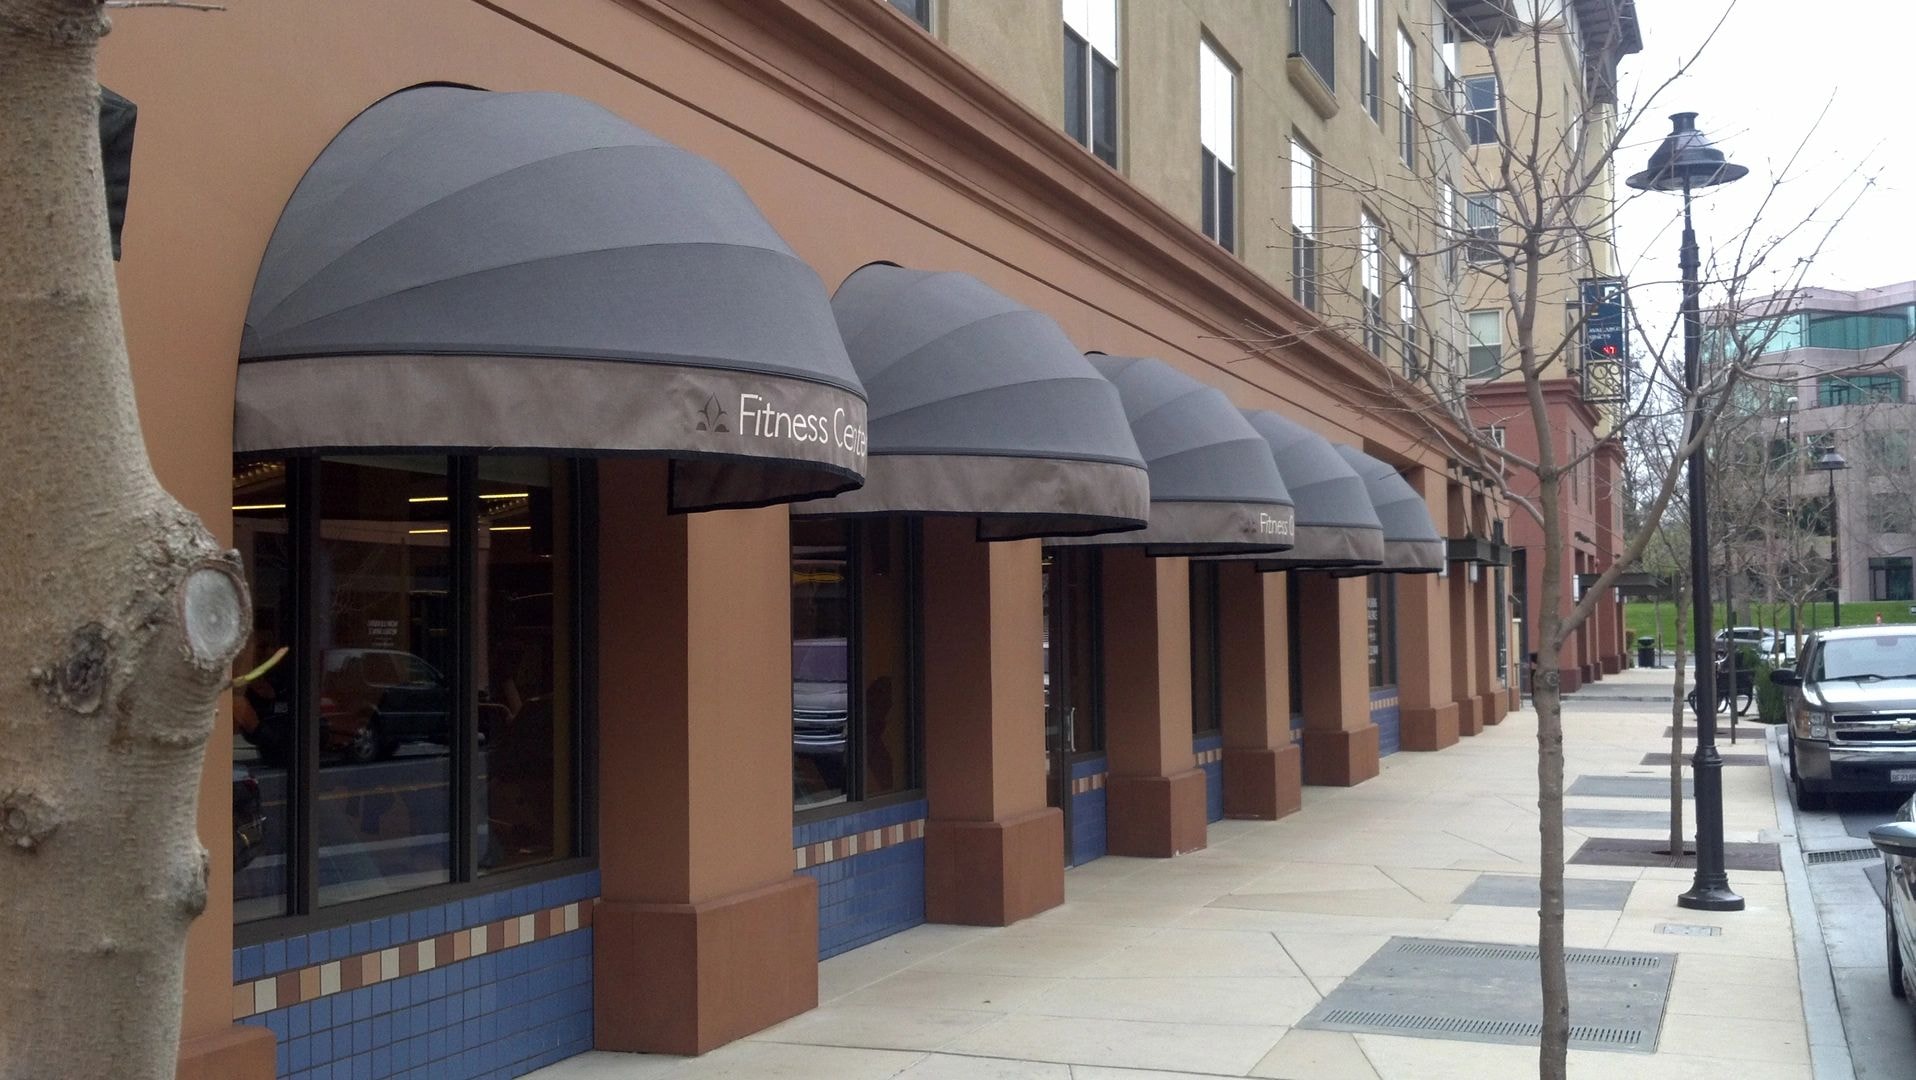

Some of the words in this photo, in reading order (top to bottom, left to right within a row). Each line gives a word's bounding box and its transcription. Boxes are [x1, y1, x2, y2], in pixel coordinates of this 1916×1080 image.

[740, 393, 828, 444] Fitness
[833, 407, 867, 457] Cente
[1260, 512, 1288, 535] Fitness
